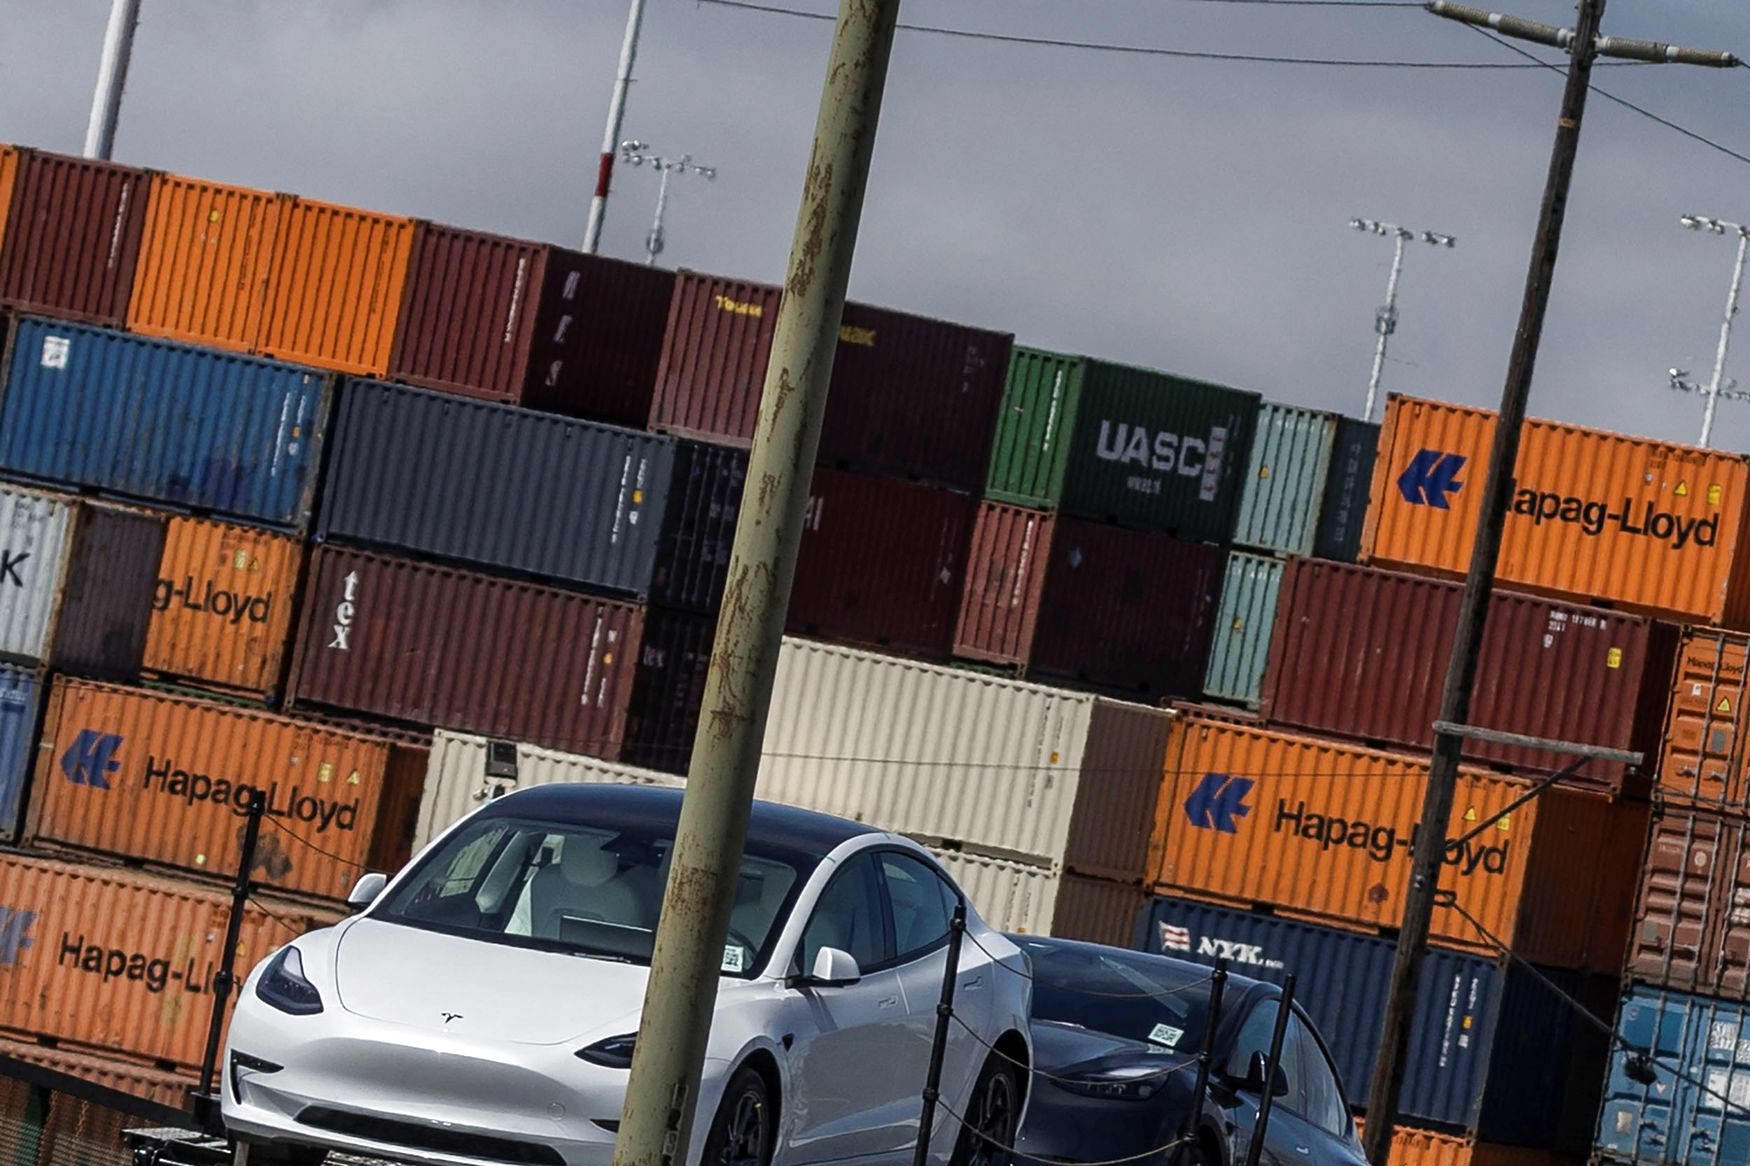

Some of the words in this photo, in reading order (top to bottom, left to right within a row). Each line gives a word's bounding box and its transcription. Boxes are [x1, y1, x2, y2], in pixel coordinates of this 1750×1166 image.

[1096, 420, 1207, 478] UASC
[1507, 477, 1720, 550] apag-Lloyd
[328, 570, 358, 650] tex
[143, 754, 360, 832] HapagLloyd
[1275, 799, 1509, 875] Hapag-oyd
[1197, 935, 1263, 965] NYK
